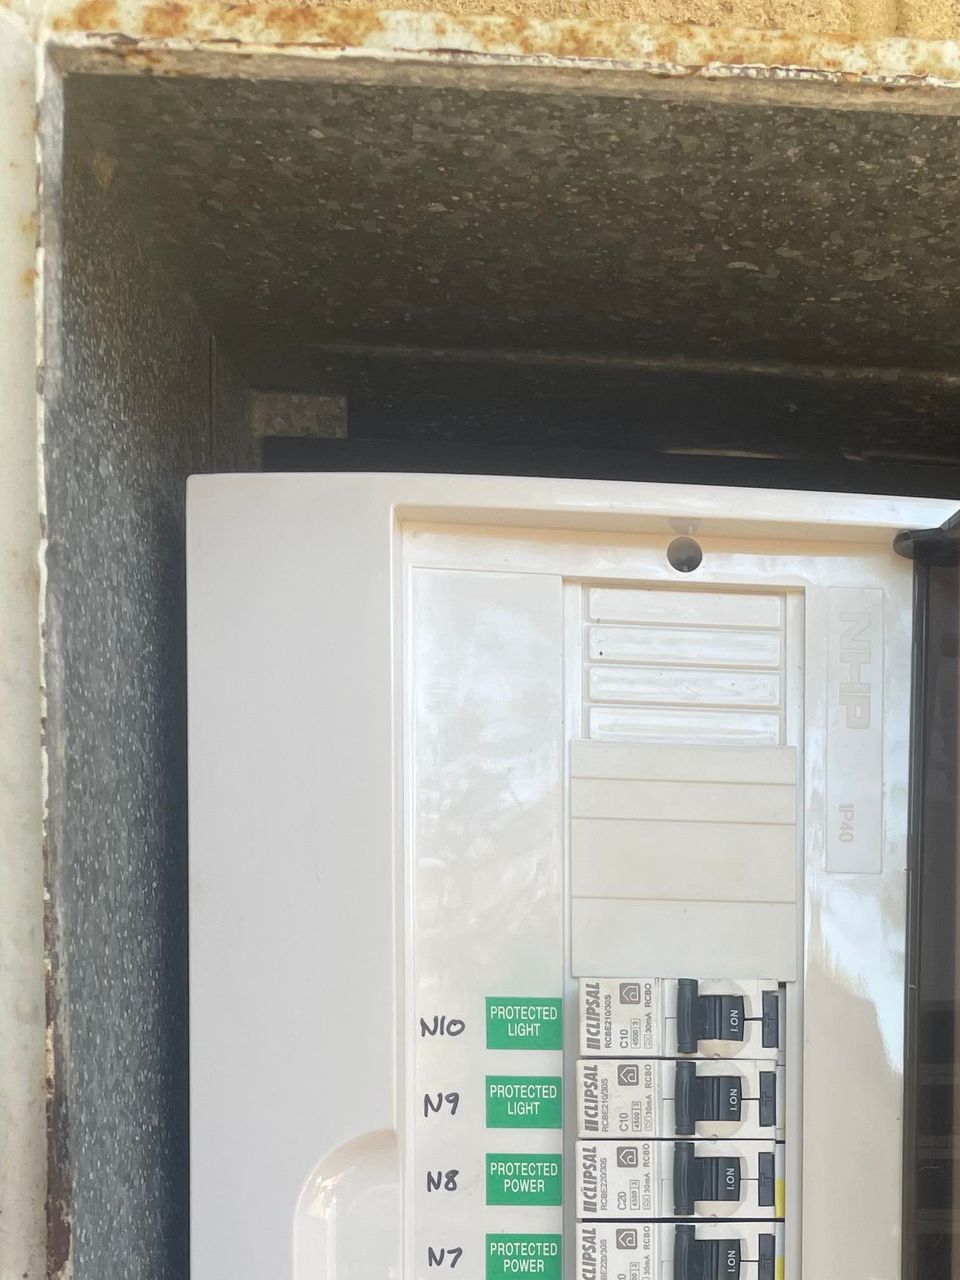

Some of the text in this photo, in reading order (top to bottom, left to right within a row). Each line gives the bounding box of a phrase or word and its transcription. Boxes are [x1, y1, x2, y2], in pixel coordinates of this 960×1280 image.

[838, 611, 872, 730] NHP
[838, 803, 855, 844] IP40
[490, 1006, 558, 1021] PROTECTED
[585, 982, 600, 1036] CLIPSAL
[420, 1015, 466, 1037] N10
[508, 1022, 541, 1037] LIGHT
[619, 1029, 629, 1049] C10
[490, 1084, 558, 1100] PROTECTED
[584, 1064, 598, 1118] CLIPSAL
[423, 1092, 460, 1118] N9
[507, 1100, 540, 1115] LIGHT
[619, 1112, 629, 1132] C10
[490, 1162, 558, 1177] PROTECTED
[583, 1146, 598, 1199] CLIPSAL
[426, 1169, 460, 1193] N8
[503, 1178, 545, 1193] POWER
[617, 1191, 627, 1210] C20
[427, 1247, 463, 1269] N7
[490, 1242, 558, 1258] PROTECTED
[582, 1228, 597, 1280] CLIPSAL
[503, 1258, 545, 1273] POWER
